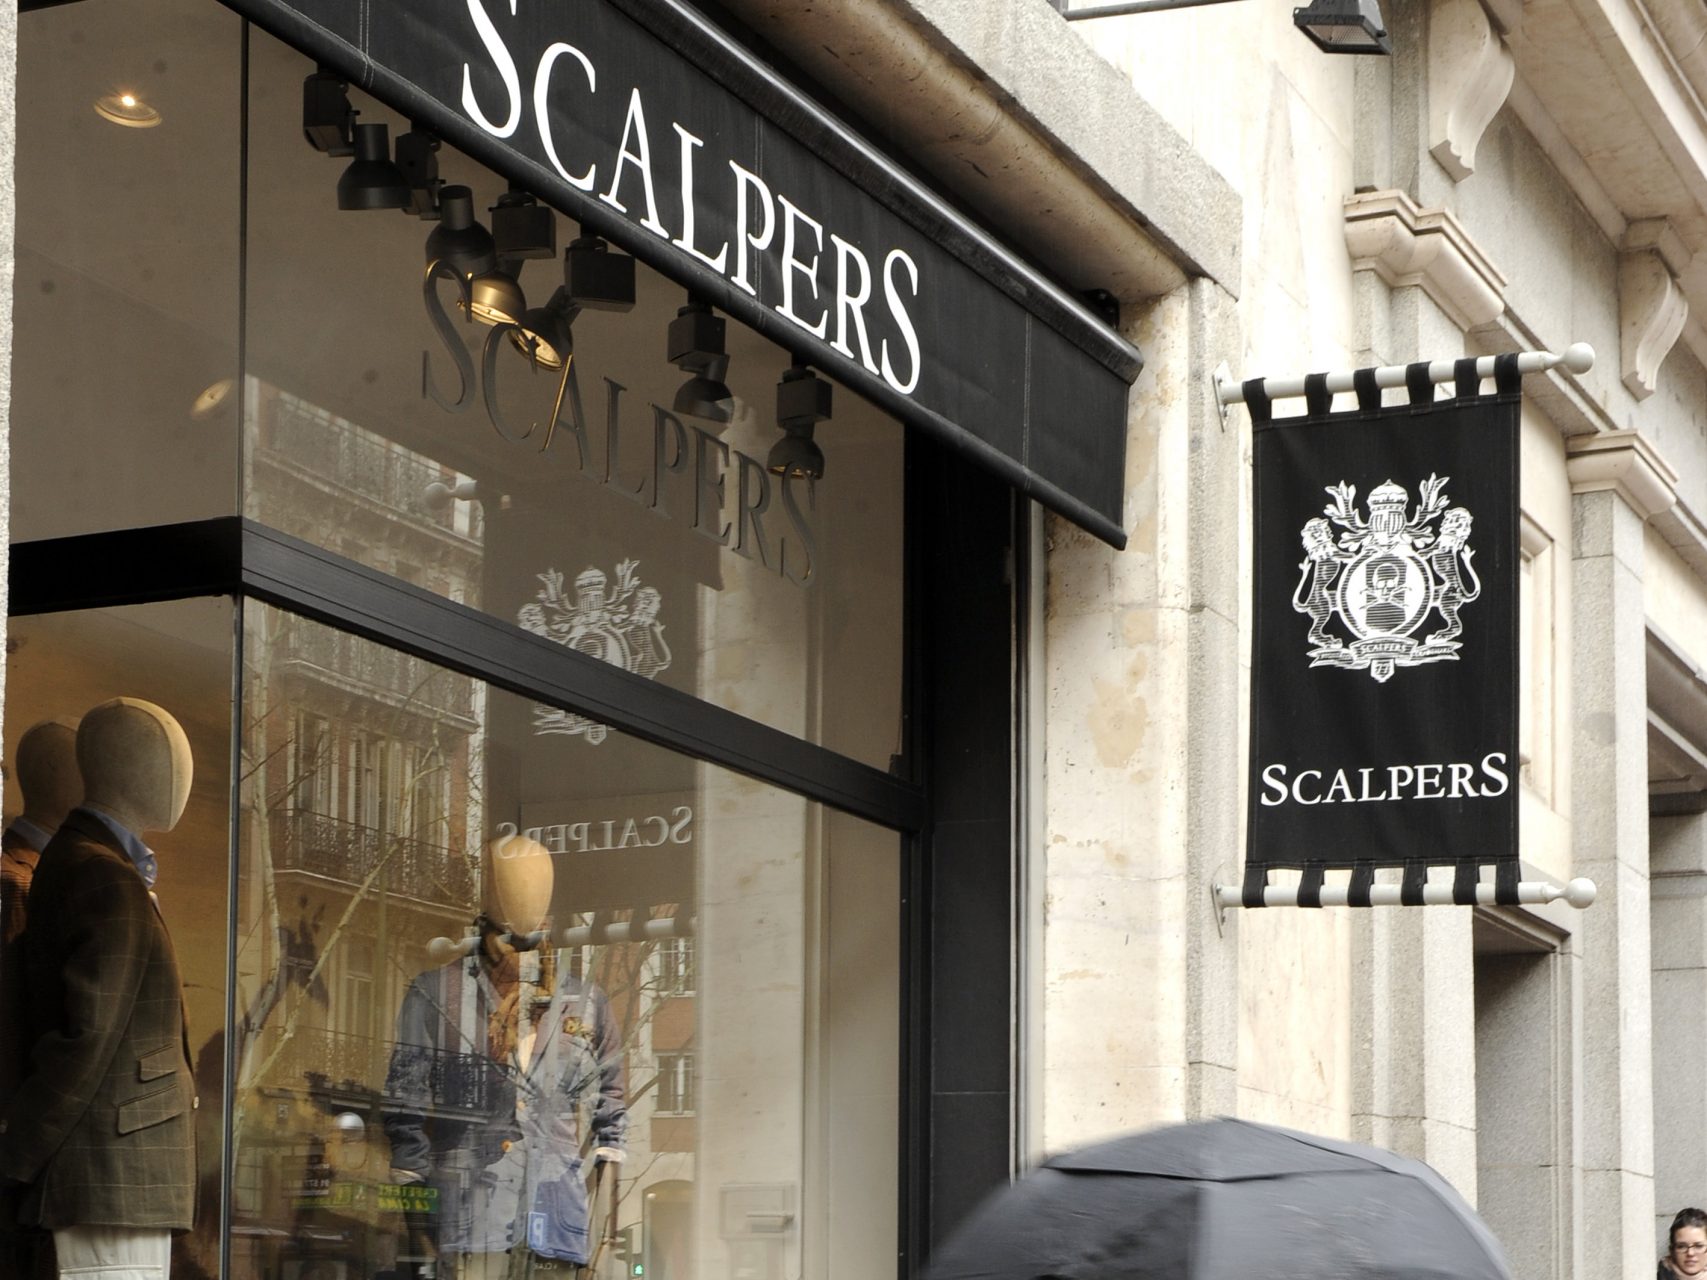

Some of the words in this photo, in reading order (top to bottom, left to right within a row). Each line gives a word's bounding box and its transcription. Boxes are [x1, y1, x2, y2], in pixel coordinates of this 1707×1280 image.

[461, 0, 921, 395] SCALPERS
[422, 258, 817, 587] SCALPERS
[1260, 751, 1509, 806] SCALPERS
